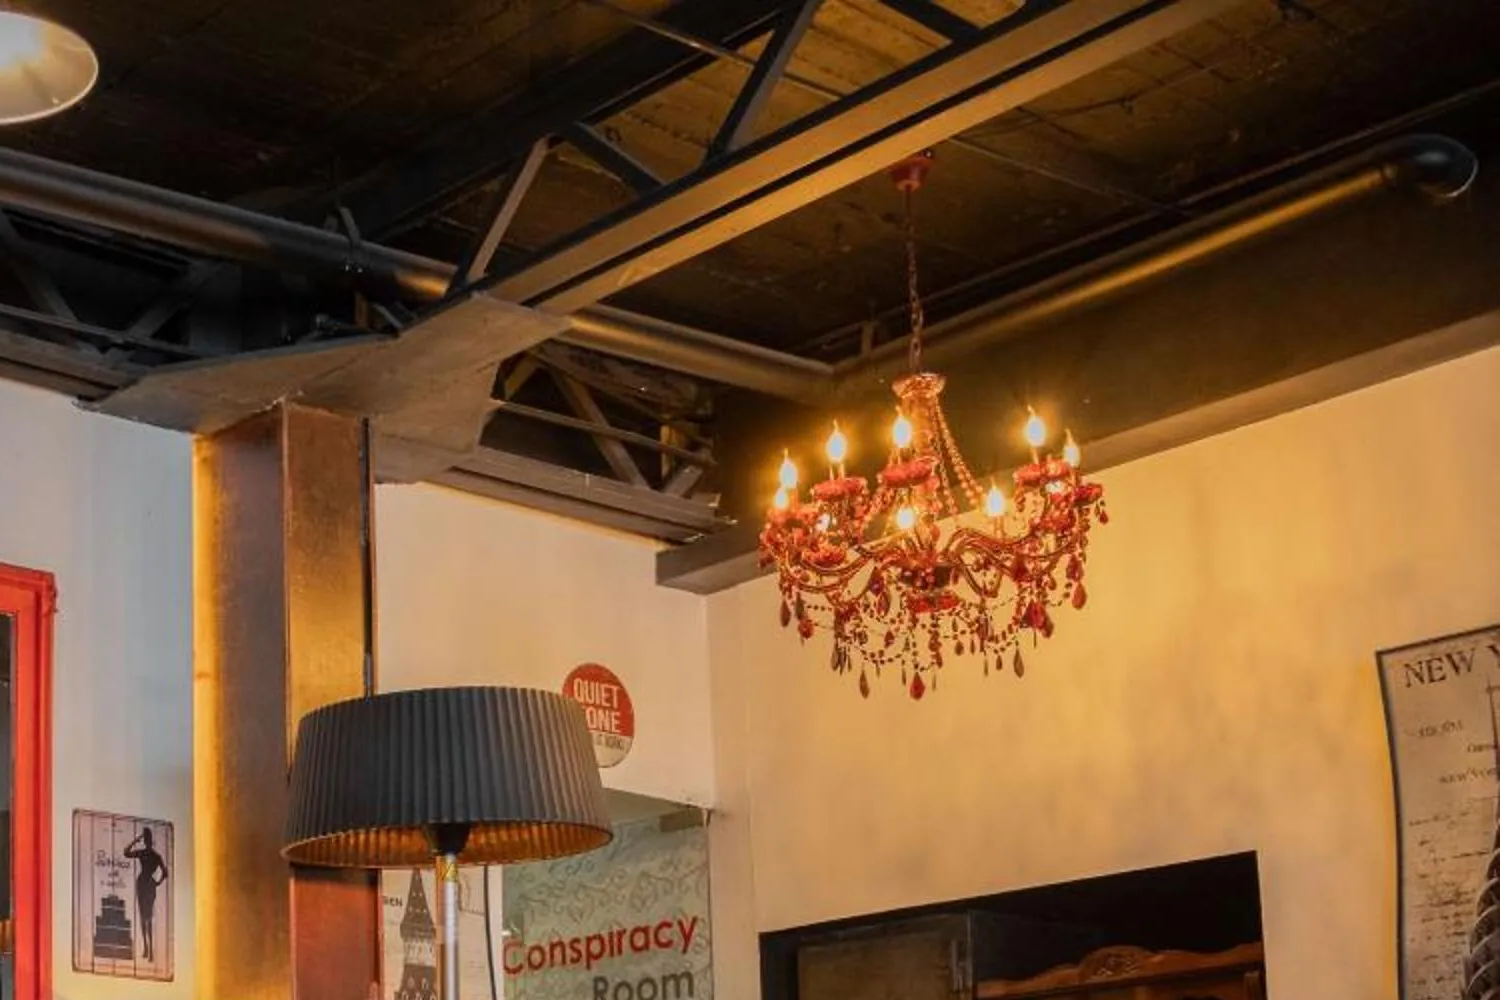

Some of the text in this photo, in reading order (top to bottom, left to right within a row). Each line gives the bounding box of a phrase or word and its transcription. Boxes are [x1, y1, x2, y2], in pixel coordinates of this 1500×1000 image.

[1402, 648, 1476, 688] NEW
[573, 677, 620, 710] QUIET
[583, 705, 622, 733] ONE
[502, 915, 699, 977] Conspiracy
